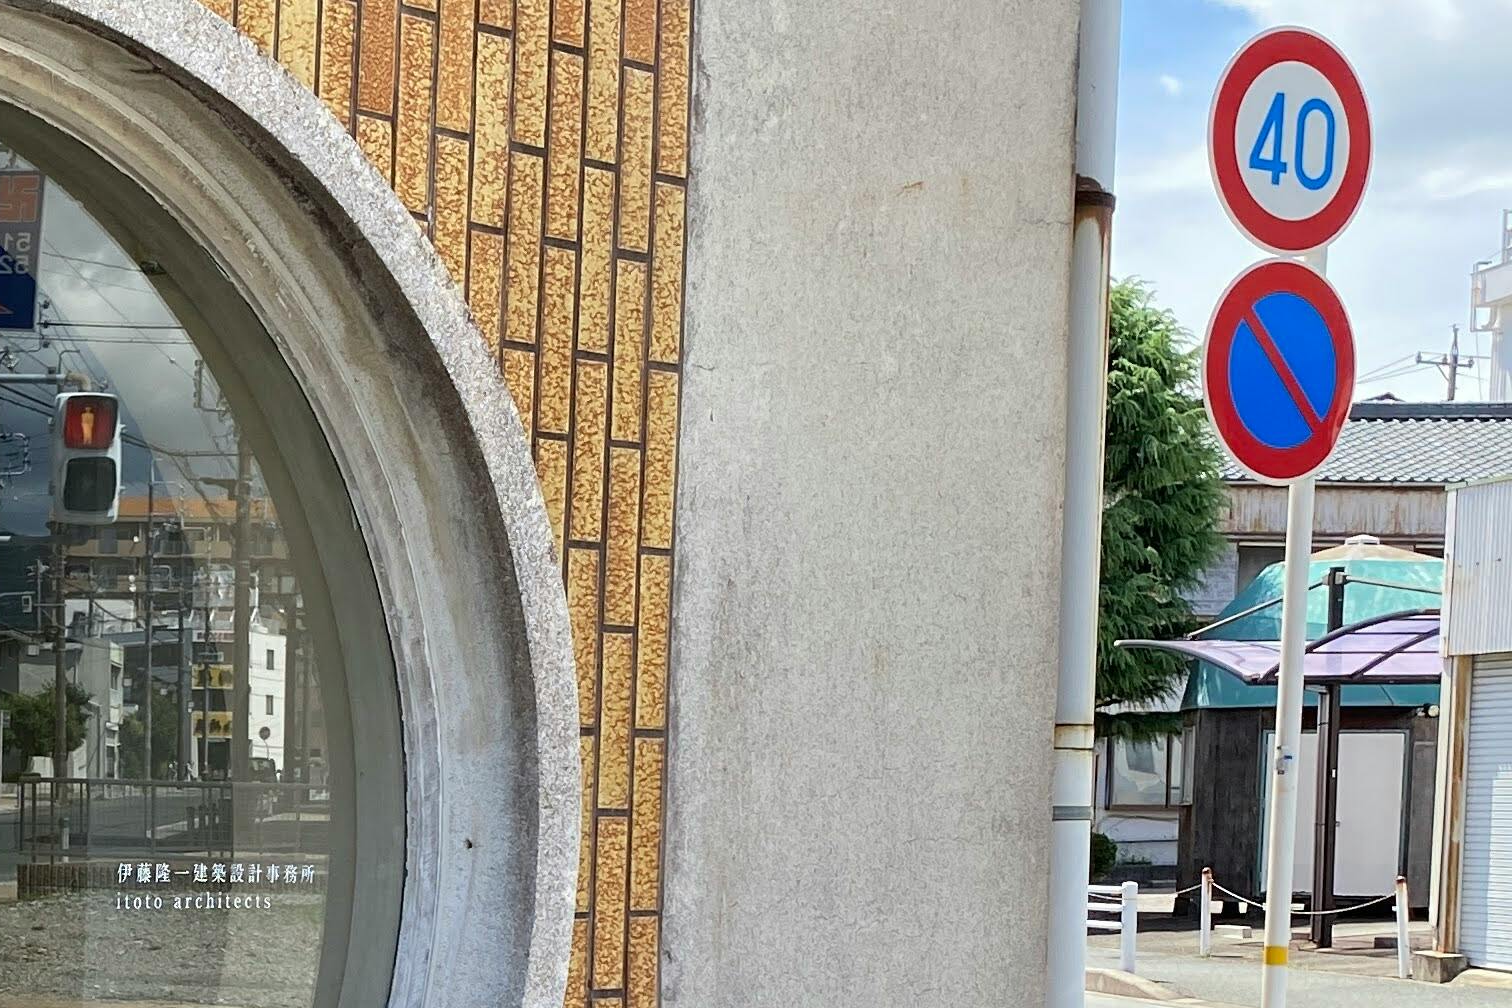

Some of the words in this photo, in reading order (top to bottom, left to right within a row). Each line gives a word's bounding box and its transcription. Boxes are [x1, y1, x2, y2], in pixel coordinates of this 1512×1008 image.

[1248, 92, 1336, 191] 40
[117, 862, 316, 885] 伊藤隆一建築設計事務所
[116, 891, 163, 910] itoto
[173, 891, 272, 910] architects
